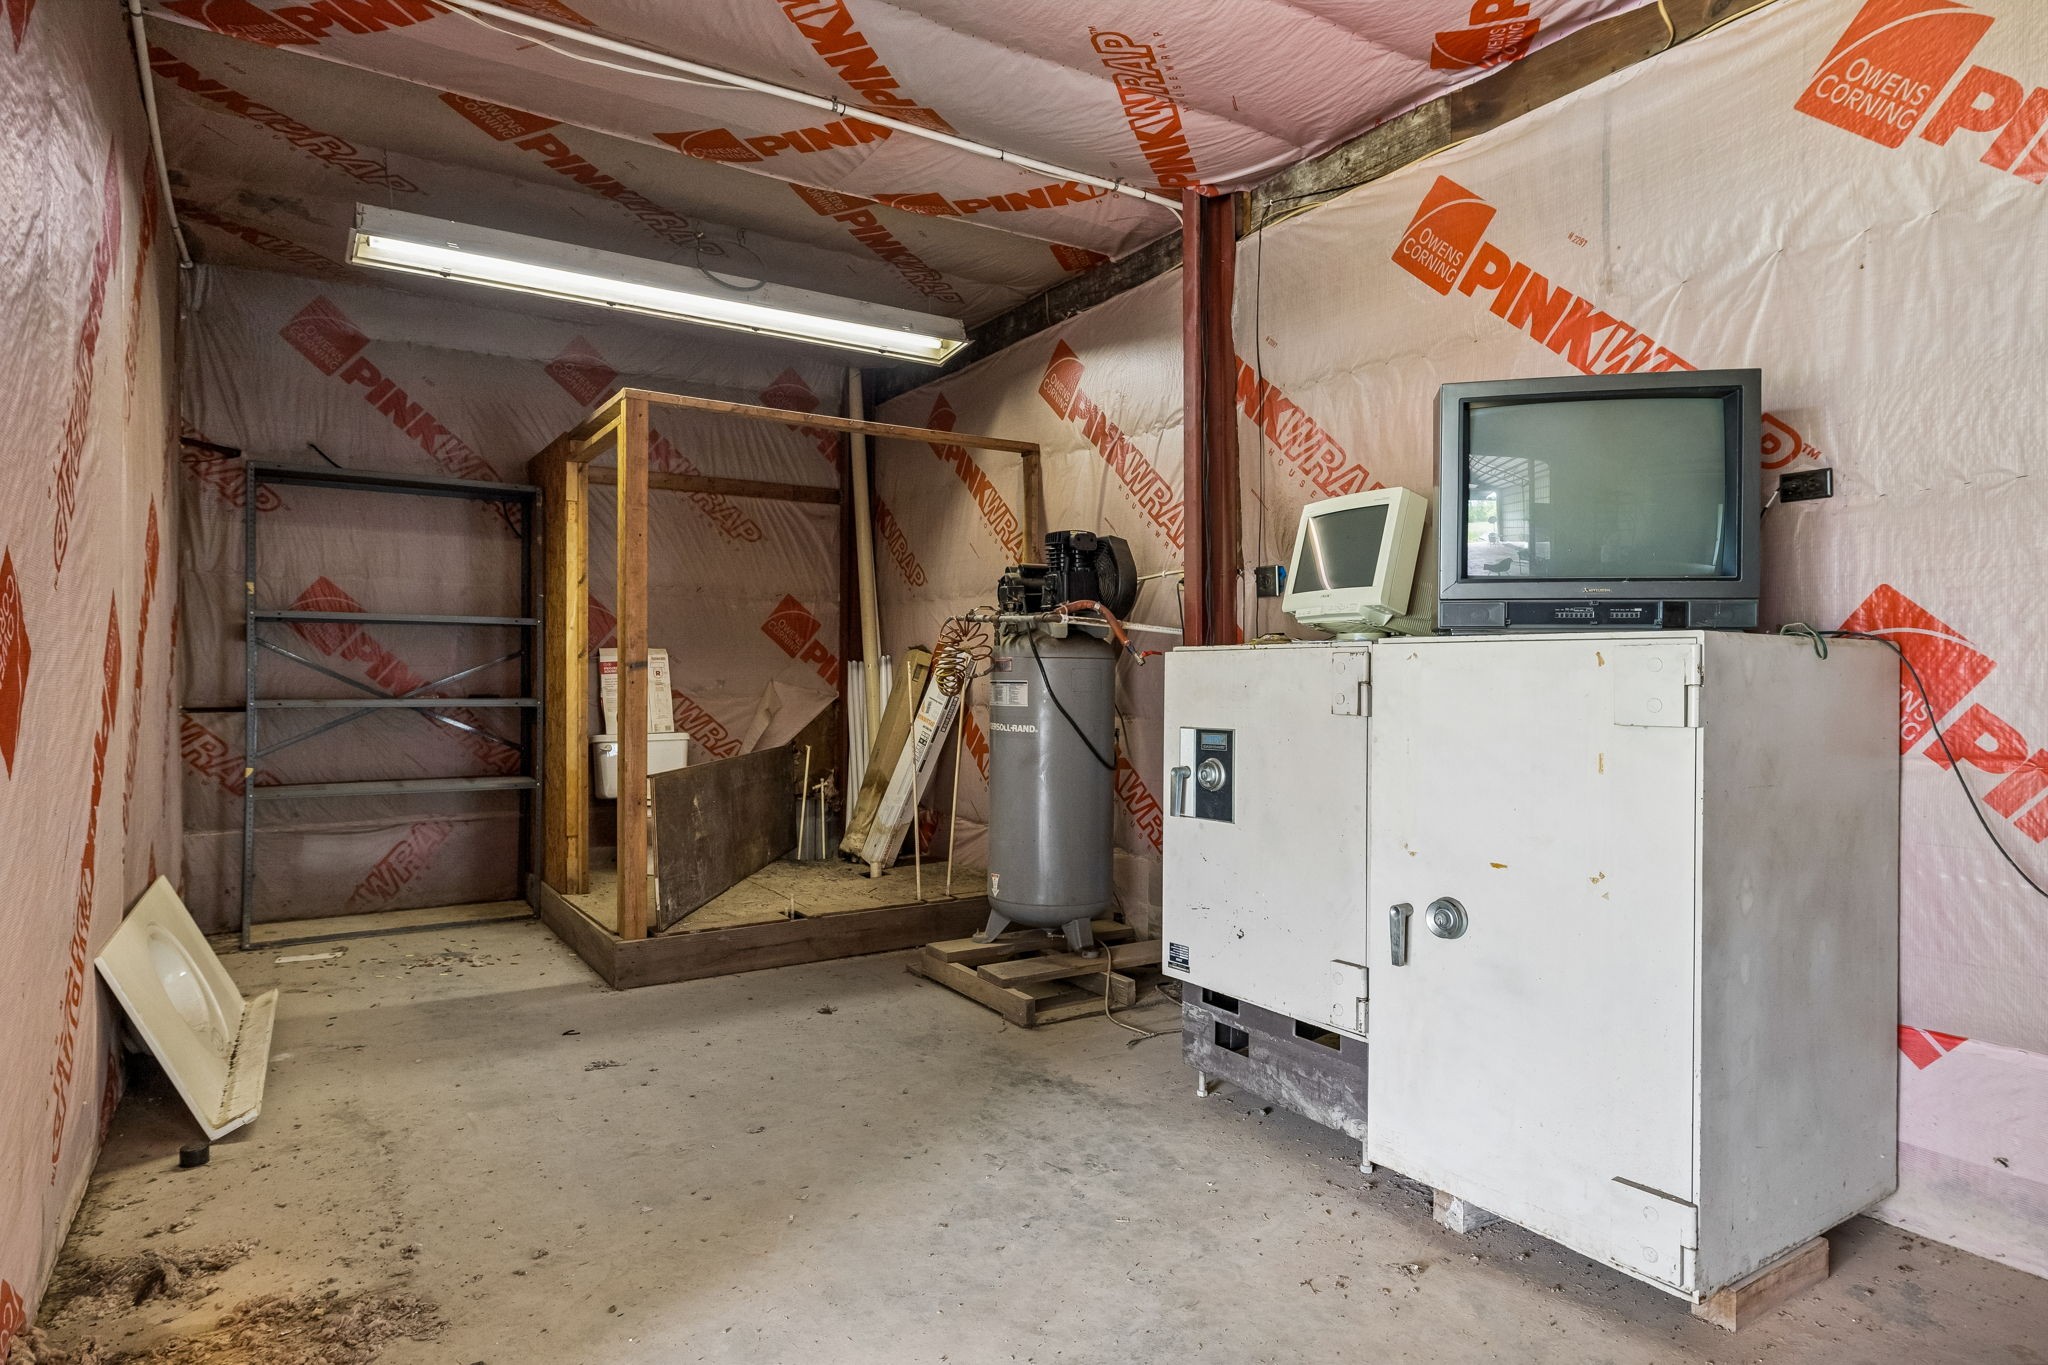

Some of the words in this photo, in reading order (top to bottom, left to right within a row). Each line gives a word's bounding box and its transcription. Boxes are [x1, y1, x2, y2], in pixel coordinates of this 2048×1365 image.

[1815, 74, 1918, 130] CORNING
[1845, 57, 1931, 106] OWENS
[148, 46, 423, 195] INKWRAP
[1919, 64, 2048, 185] PI
[1403, 237, 1458, 284] CORNING
[1419, 227, 1464, 267] OWENS
[1043, 378, 1067, 412] CORNING
[1050, 373, 1071, 402] OWENS
[1234, 354, 1387, 497] NKWRA
[873, 492, 926, 587] KWRAP
[672, 690, 743, 758] WRA
